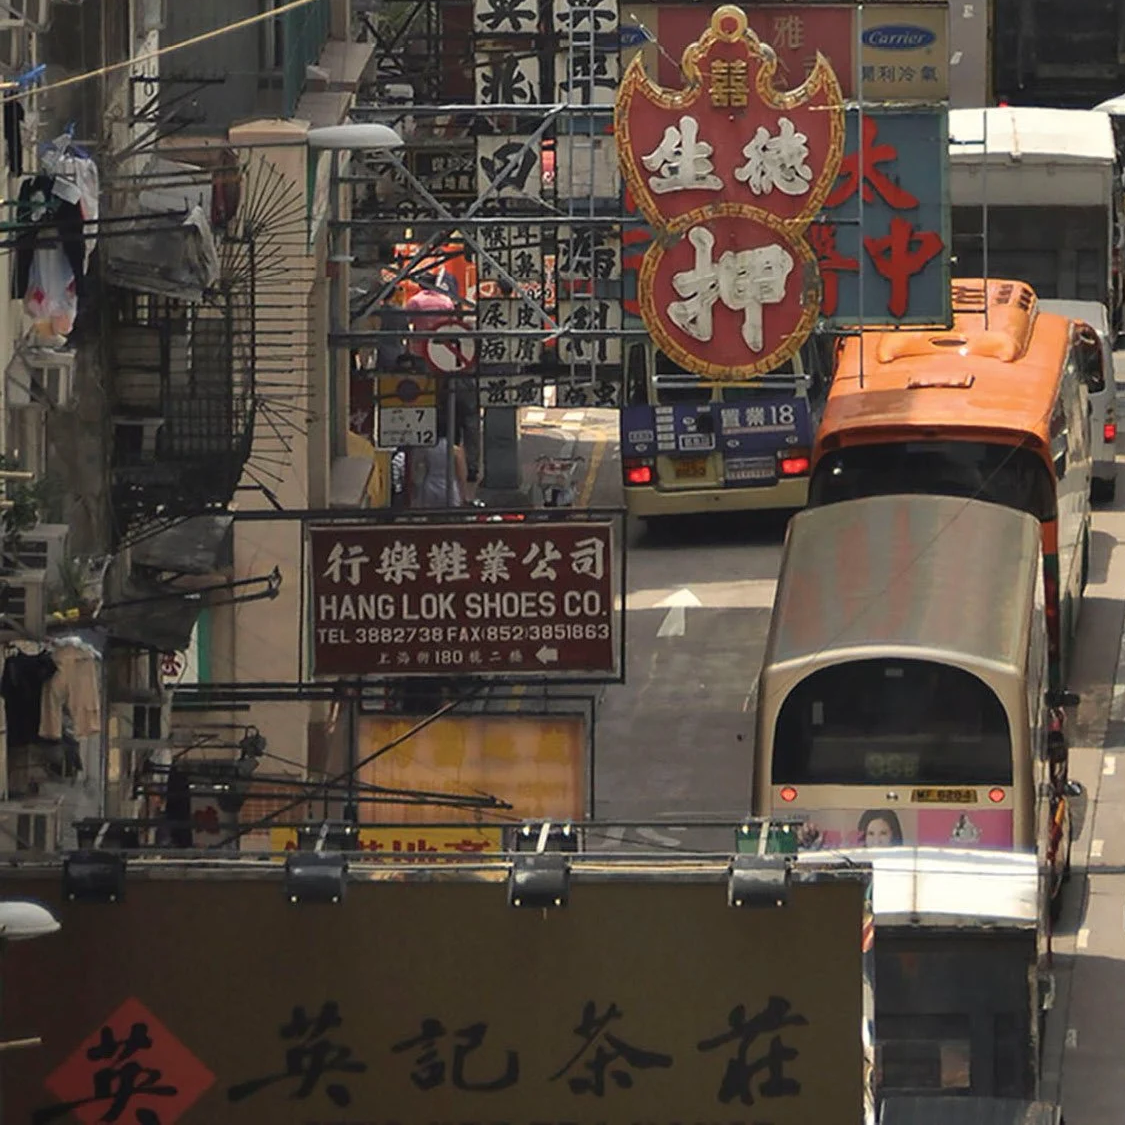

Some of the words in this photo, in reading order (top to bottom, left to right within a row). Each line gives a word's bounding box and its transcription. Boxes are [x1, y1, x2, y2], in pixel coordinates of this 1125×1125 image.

[866, 29, 927, 46] Carrier
[666, 225, 794, 353] 押
[322, 536, 606, 586] 行樂鞋業公司
[319, 593, 396, 622] HANG
[402, 592, 457, 620] LOK
[465, 591, 557, 619] SHOES
[563, 589, 608, 617] CO.
[317, 628, 350, 644] TEL
[355, 626, 444, 643] 3882738
[32, 1019, 179, 1125] 英
[228, 995, 812, 1108] 英記茶莊
